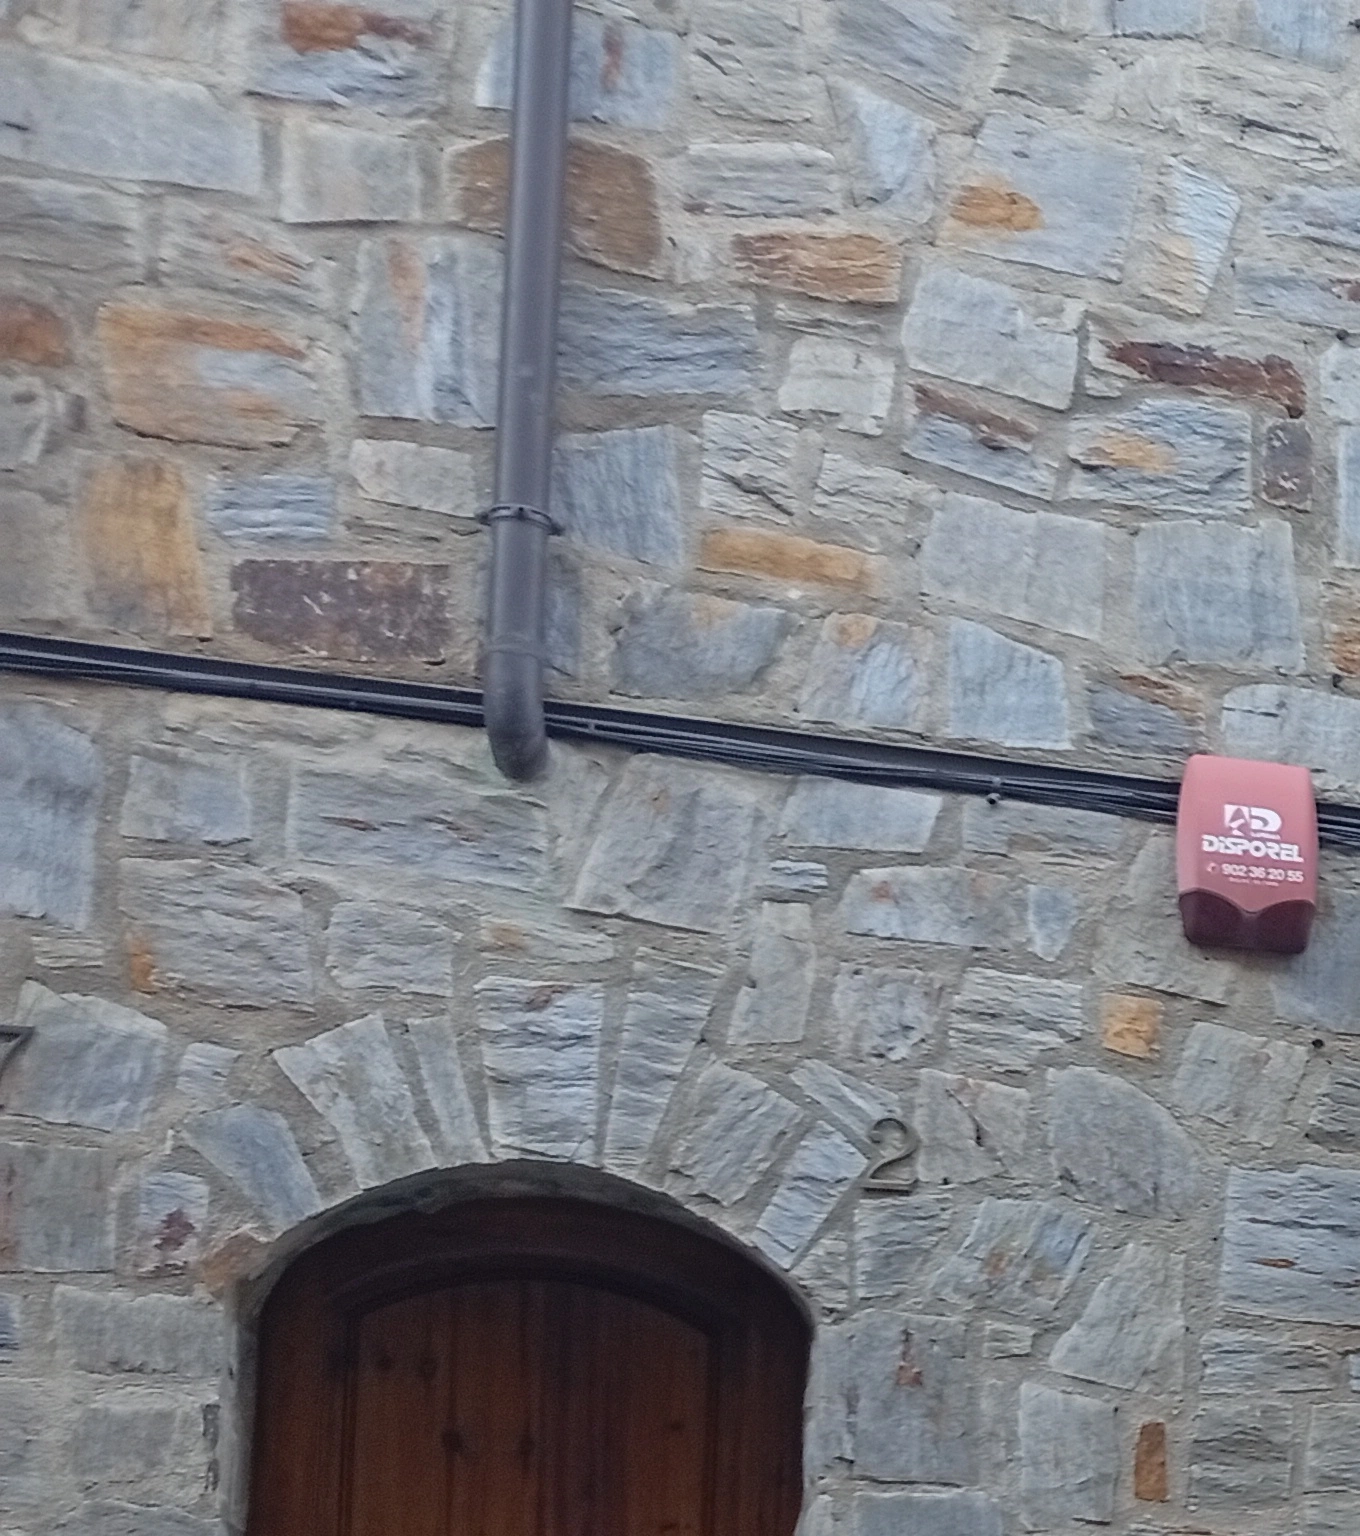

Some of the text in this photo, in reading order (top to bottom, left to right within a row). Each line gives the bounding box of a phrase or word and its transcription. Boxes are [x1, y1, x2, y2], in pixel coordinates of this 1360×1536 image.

[1221, 863, 1248, 877] 902
[1248, 865, 1266, 879] 36
[1266, 867, 1285, 881] 20
[1286, 869, 1304, 883] 55
